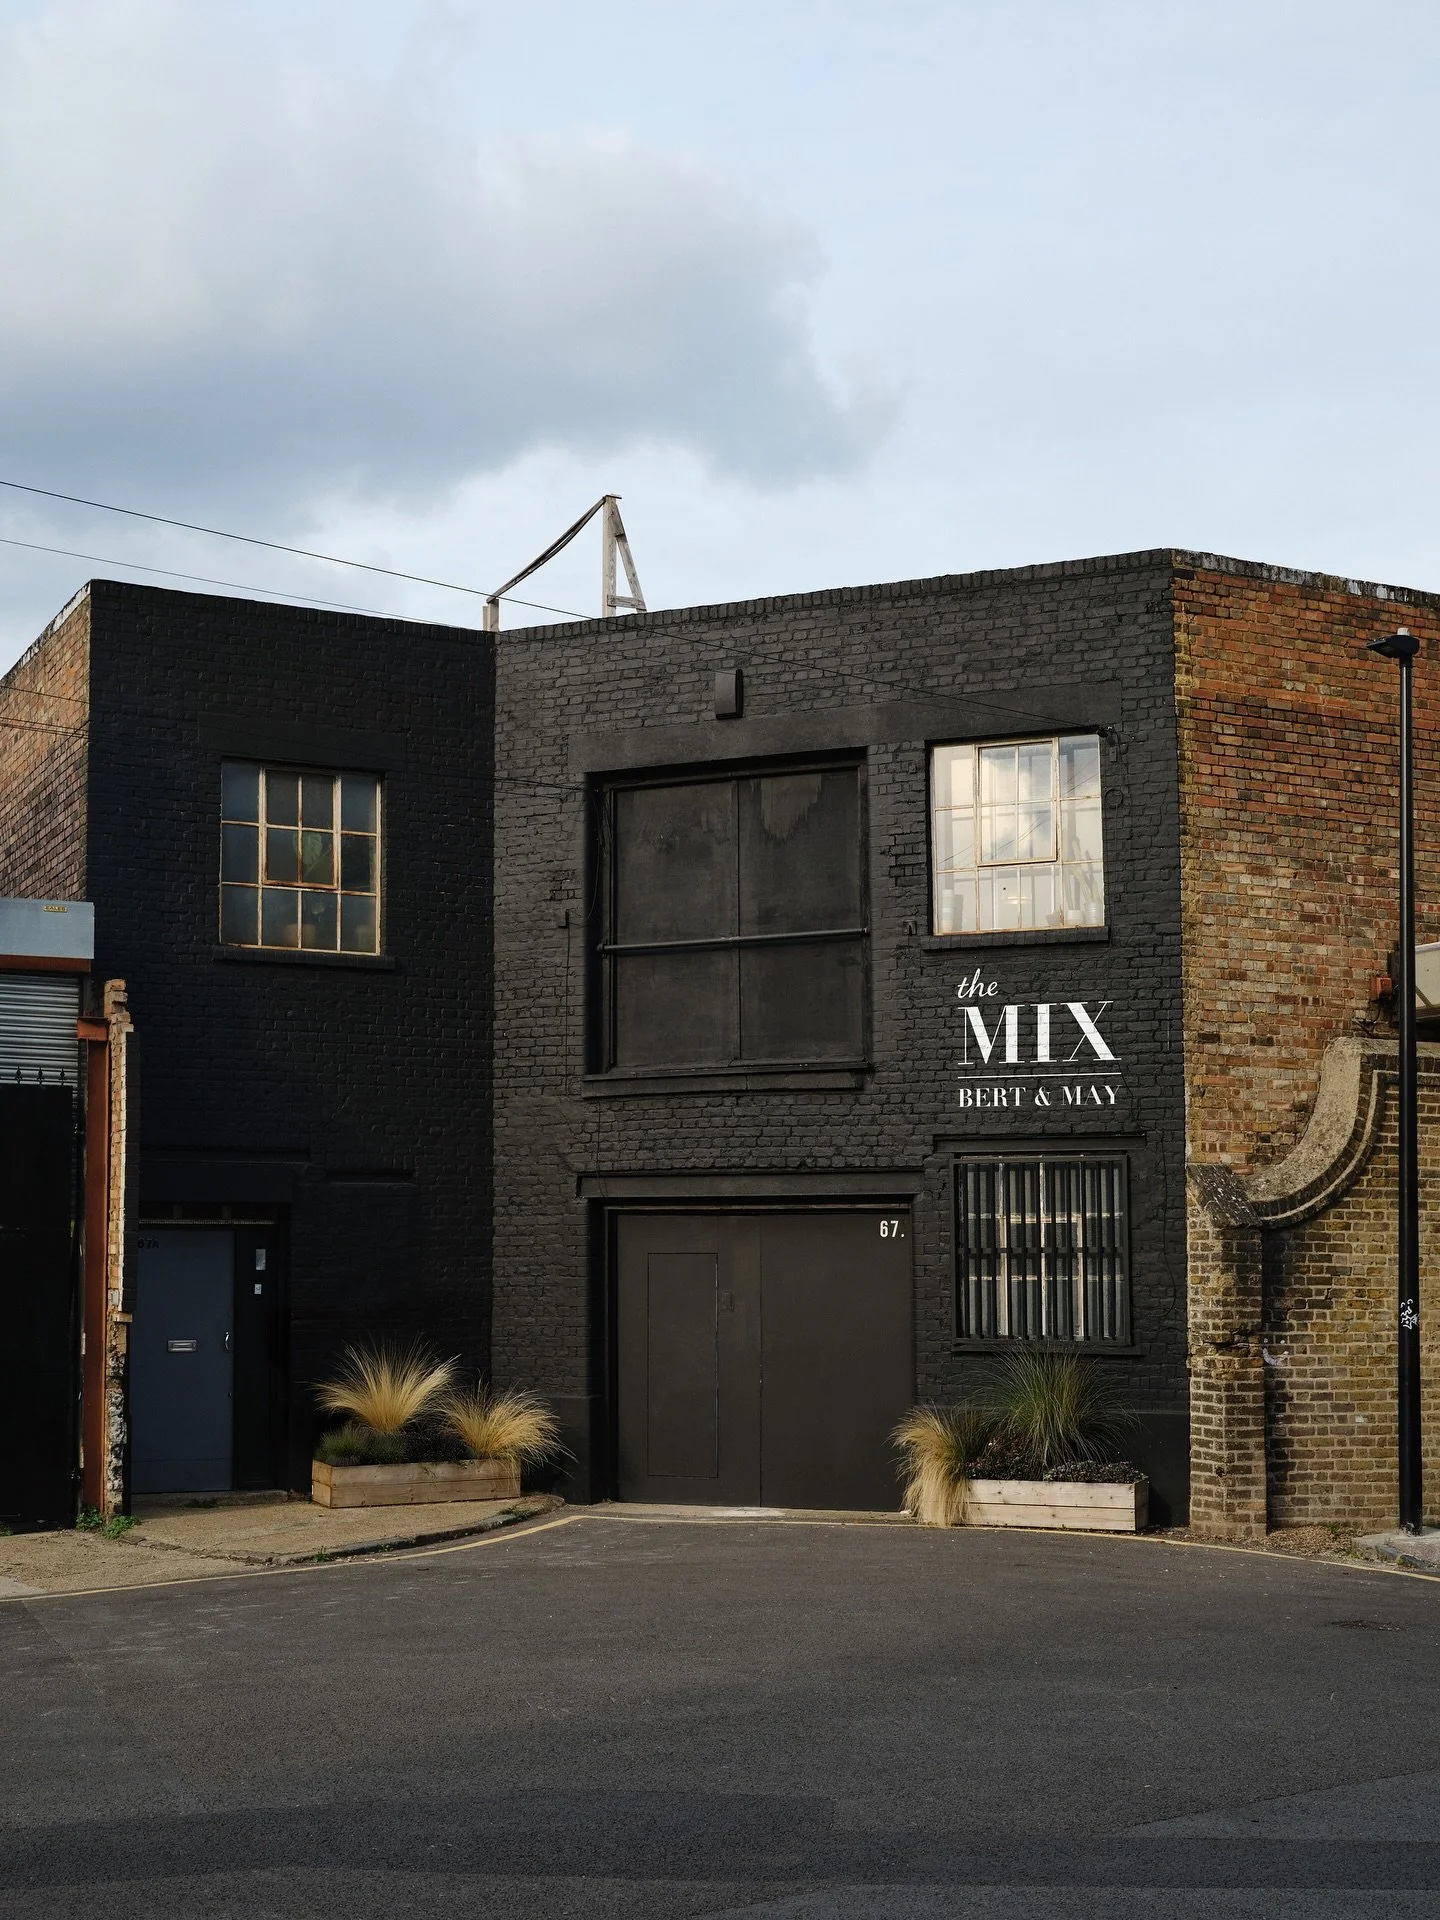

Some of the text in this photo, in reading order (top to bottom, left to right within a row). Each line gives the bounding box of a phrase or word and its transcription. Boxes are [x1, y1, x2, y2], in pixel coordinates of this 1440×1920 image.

[957, 968, 999, 999] the
[957, 1000, 1122, 1065] MIX
[958, 1084, 1123, 1108] BERT & MAY
[880, 1220, 905, 1238] 67.
